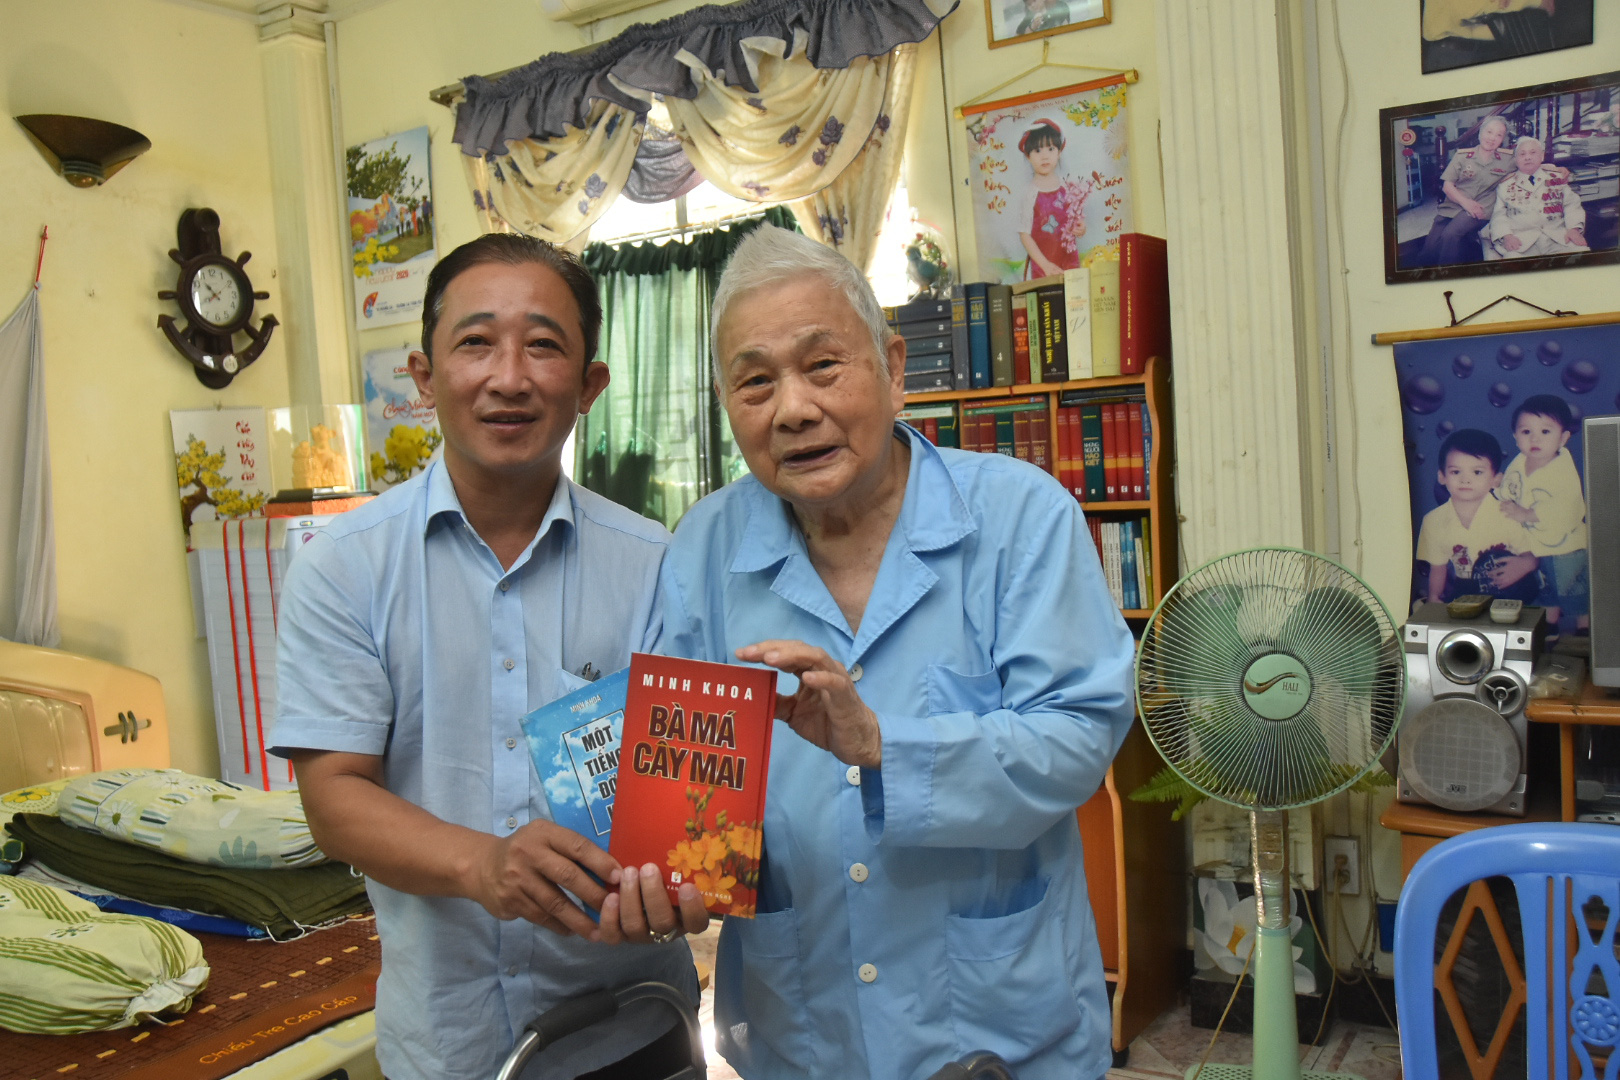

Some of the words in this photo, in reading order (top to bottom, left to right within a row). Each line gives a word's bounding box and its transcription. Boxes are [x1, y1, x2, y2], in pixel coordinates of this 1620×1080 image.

[570, 701, 586, 713] MINH
[584, 693, 603, 707] KHOA
[643, 674, 691, 692] MINH
[702, 682, 753, 701] KHOA
[648, 701, 686, 742] BÀ
[689, 710, 736, 750] MÁ
[632, 740, 690, 781] CÂY
[688, 750, 747, 791] MAI
[200, 1040, 255, 1064] Chiếu
[252, 1025, 285, 1040] Tre
[284, 1009, 322, 1026] Cao
[321, 995, 358, 1011] Cấp
